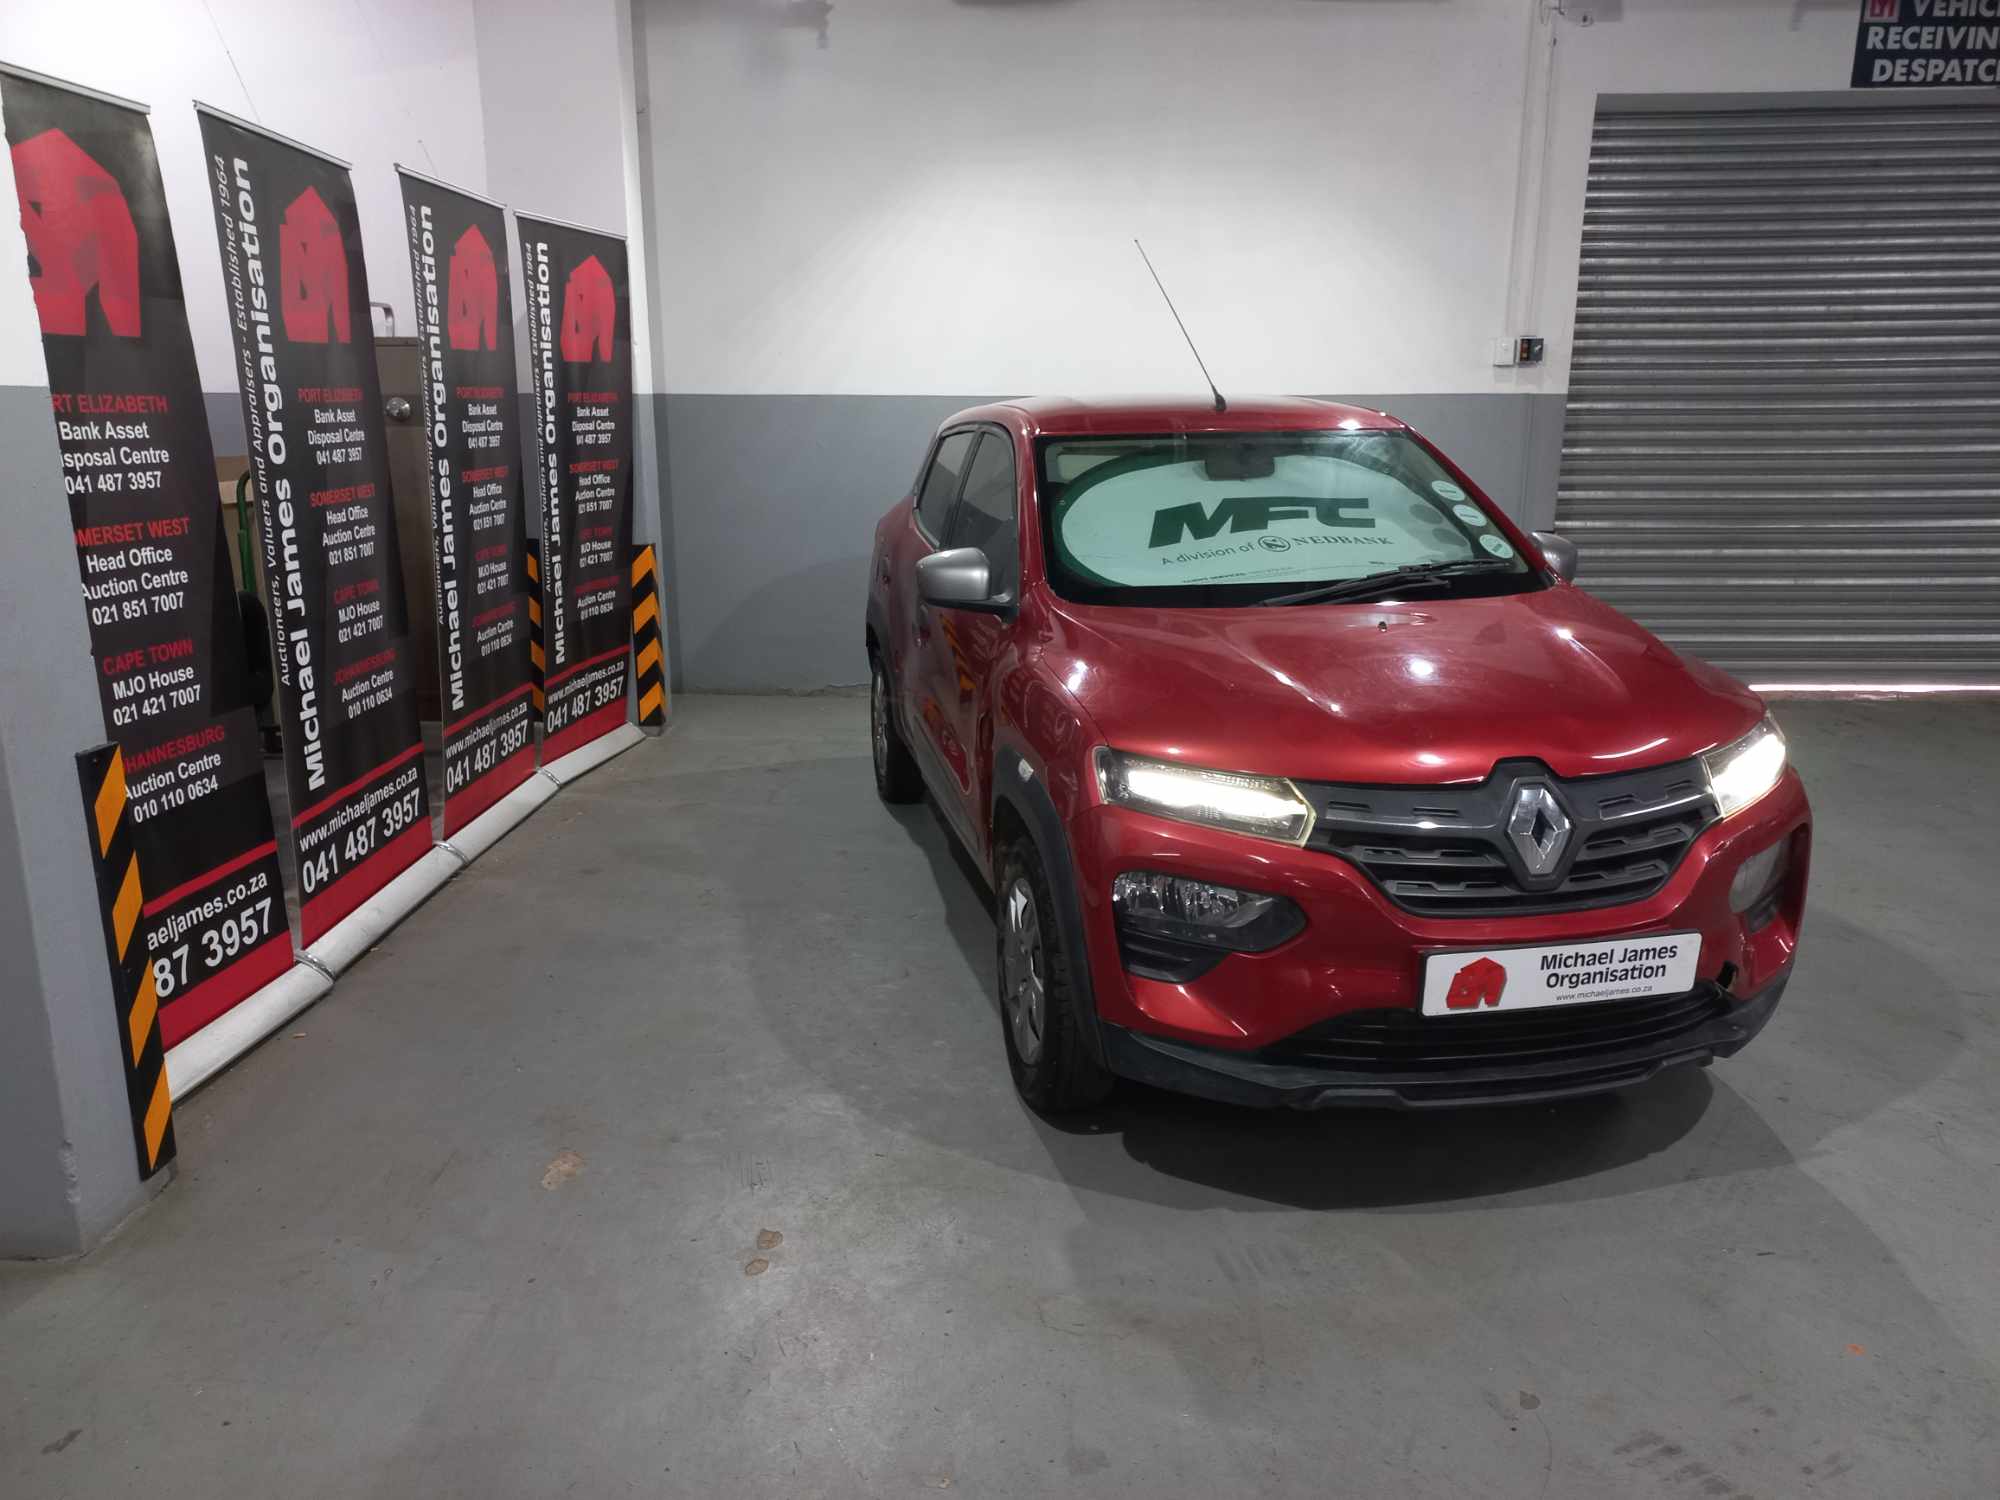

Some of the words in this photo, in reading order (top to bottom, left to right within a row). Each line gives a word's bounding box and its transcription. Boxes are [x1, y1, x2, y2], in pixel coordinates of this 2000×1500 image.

[1914, 0, 2000, 17] VEHIC
[1866, 26, 2000, 50] RECEIVIN
[214, 154, 231, 208] 1964
[221, 213, 247, 332] Established
[233, 157, 286, 465] Organisation
[421, 206, 447, 447] Organisation
[537, 242, 556, 444] Organisation
[77, 394, 168, 413] ELIZABETH
[242, 349, 261, 451] Appraisers
[314, 408, 336, 423] Bank
[337, 408, 356, 422] Asset
[58, 421, 101, 440] Bank
[105, 421, 150, 439] Asset
[307, 429, 343, 447] Disposal
[344, 428, 365, 442] Centre
[120, 446, 170, 465] Centre
[316, 450, 330, 465] 041
[332, 449, 346, 463] 487
[347, 447, 362, 462] 3957
[64, 475, 93, 495] 041
[97, 472, 122, 492] 487
[128, 471, 161, 490] 3957
[254, 456, 267, 493] and
[326, 509, 346, 525] Head
[347, 506, 368, 521] Office
[439, 459, 456, 570] James
[548, 453, 561, 547] James
[147, 516, 190, 539] WEST
[262, 500, 276, 568] Valuers
[322, 529, 352, 547] Auction
[354, 524, 376, 540] Centre
[1148, 496, 1376, 549] MFC
[86, 550, 126, 573] Head
[129, 546, 173, 566] Office
[275, 478, 305, 616] James
[329, 549, 342, 566] 021
[344, 545, 358, 562] 851
[359, 541, 374, 558] 7007
[1161, 557, 1172, 566] A
[1176, 546, 1236, 562] division
[1240, 542, 1255, 553] of
[1292, 535, 1395, 546] NEDBANK
[81, 578, 138, 600] Auction
[141, 569, 189, 590] Centre
[92, 604, 119, 625] 021
[122, 598, 148, 620] 851
[151, 591, 184, 613] 7007
[338, 605, 356, 623] MJO
[356, 600, 380, 616] House
[551, 555, 565, 664] Michael
[273, 575, 290, 686] Auctioneers,
[338, 627, 352, 643] 021
[353, 620, 367, 637] 421
[367, 615, 383, 633] 7007
[444, 580, 464, 711] Michael
[103, 649, 145, 676] CAPE
[149, 639, 193, 663] TOWN
[112, 675, 146, 700] MJO
[148, 666, 194, 690] House
[342, 681, 370, 702] Auction
[371, 670, 394, 688] Centre
[112, 703, 138, 726] 021
[142, 694, 166, 716] 421
[169, 684, 201, 709] 7007
[290, 628, 325, 791] Michael
[348, 701, 361, 719] 010
[362, 695, 375, 711] 110
[376, 687, 393, 705] 0634
[547, 703, 568, 733] 041
[572, 690, 591, 718] 487
[594, 675, 624, 706] 3957
[178, 753, 221, 779] Centre
[447, 755, 470, 793] 041
[474, 738, 497, 773] 487
[500, 719, 528, 757] 3957
[134, 798, 158, 823] 010
[160, 788, 185, 811] 110
[187, 774, 219, 800] 0634
[299, 767, 417, 852] www.michaeljames.co.za
[302, 843, 338, 893] 041
[345, 816, 376, 861] 487
[382, 787, 419, 837] 3957
[147, 872, 268, 950] aeljames.co.za
[153, 944, 189, 998] 87
[201, 897, 272, 967] 3957
[1540, 948, 1615, 970] Michael
[1618, 945, 1678, 963] James
[1546, 964, 1667, 989] Organisation
